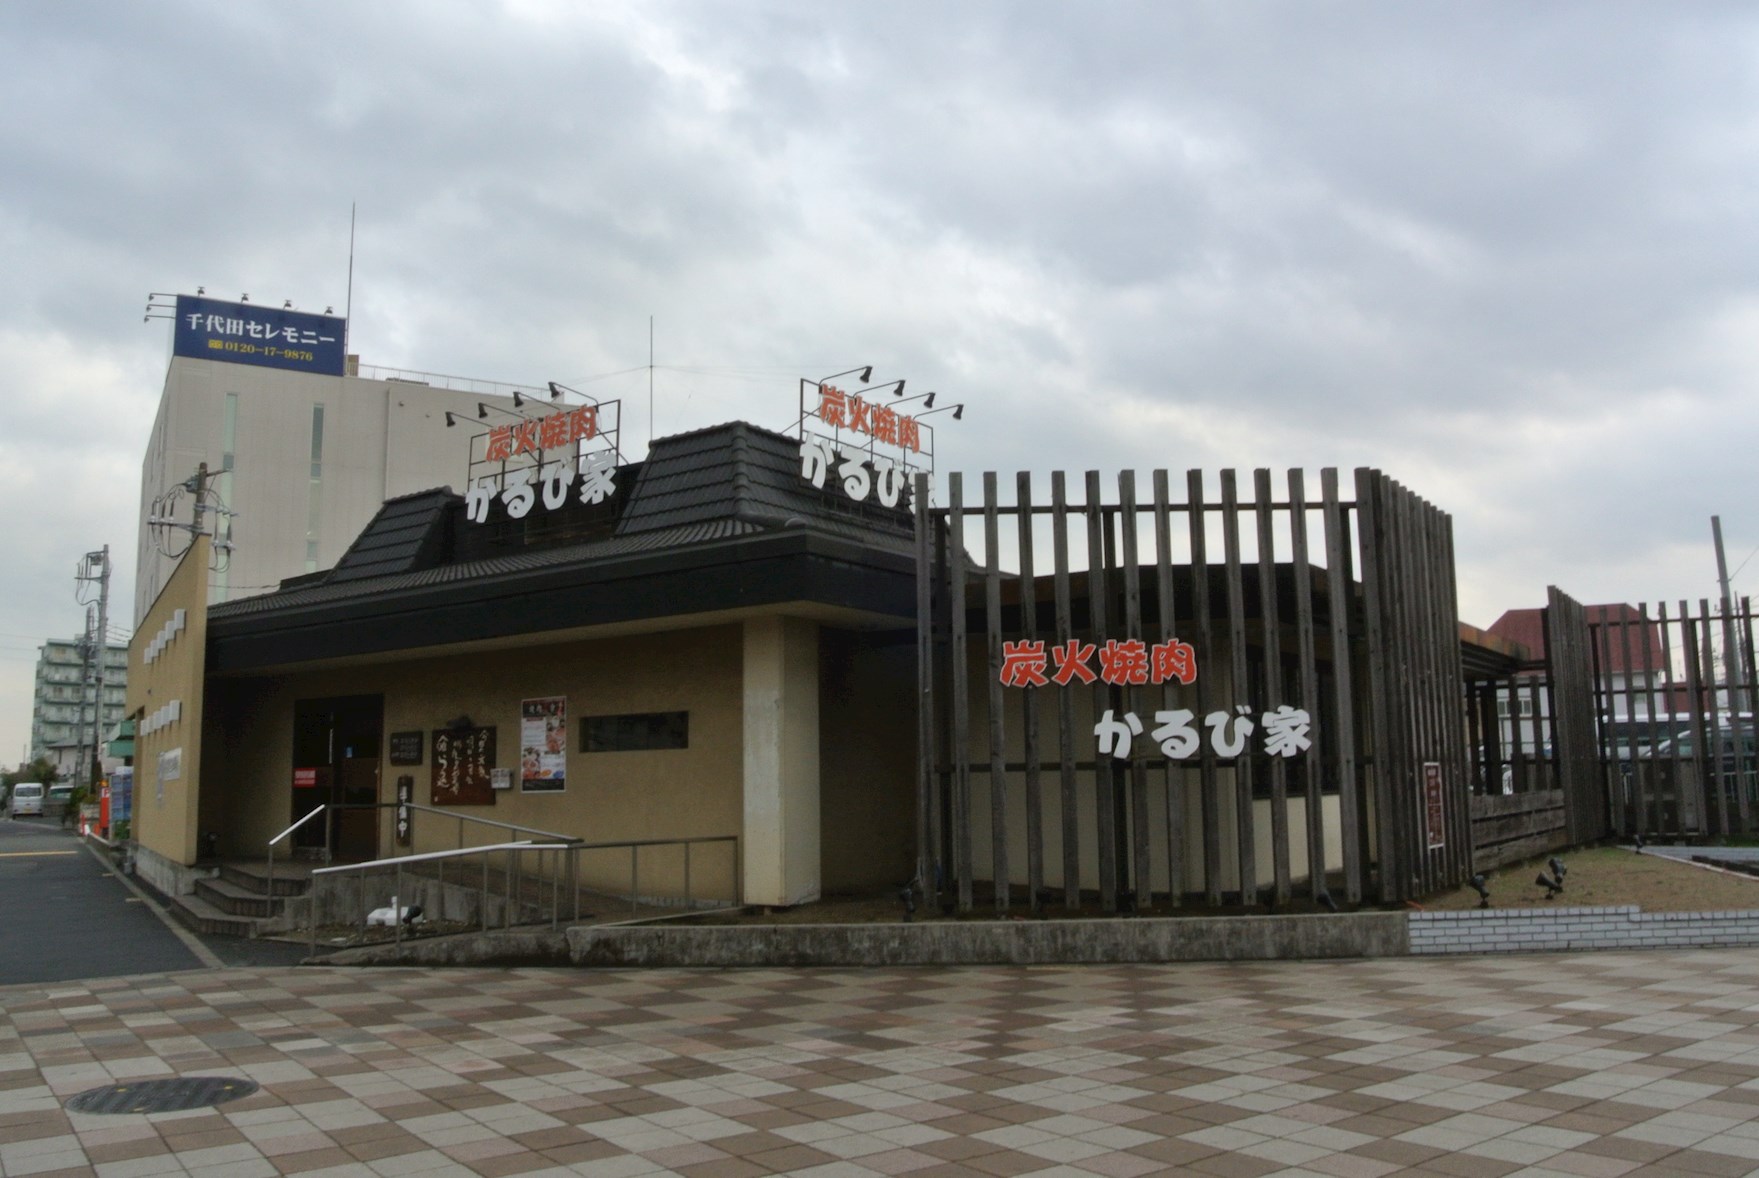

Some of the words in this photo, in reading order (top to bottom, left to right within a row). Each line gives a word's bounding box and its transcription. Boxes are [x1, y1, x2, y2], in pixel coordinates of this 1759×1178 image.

[185, 312, 336, 345] 千代田セレモニー
[485, 403, 598, 463] 炭火焼肉
[819, 384, 920, 453] 炭火焼肉
[465, 451, 618, 524] かるび家
[999, 638, 1197, 687] 炭火焼肉
[1093, 705, 1312, 760] かるび家
